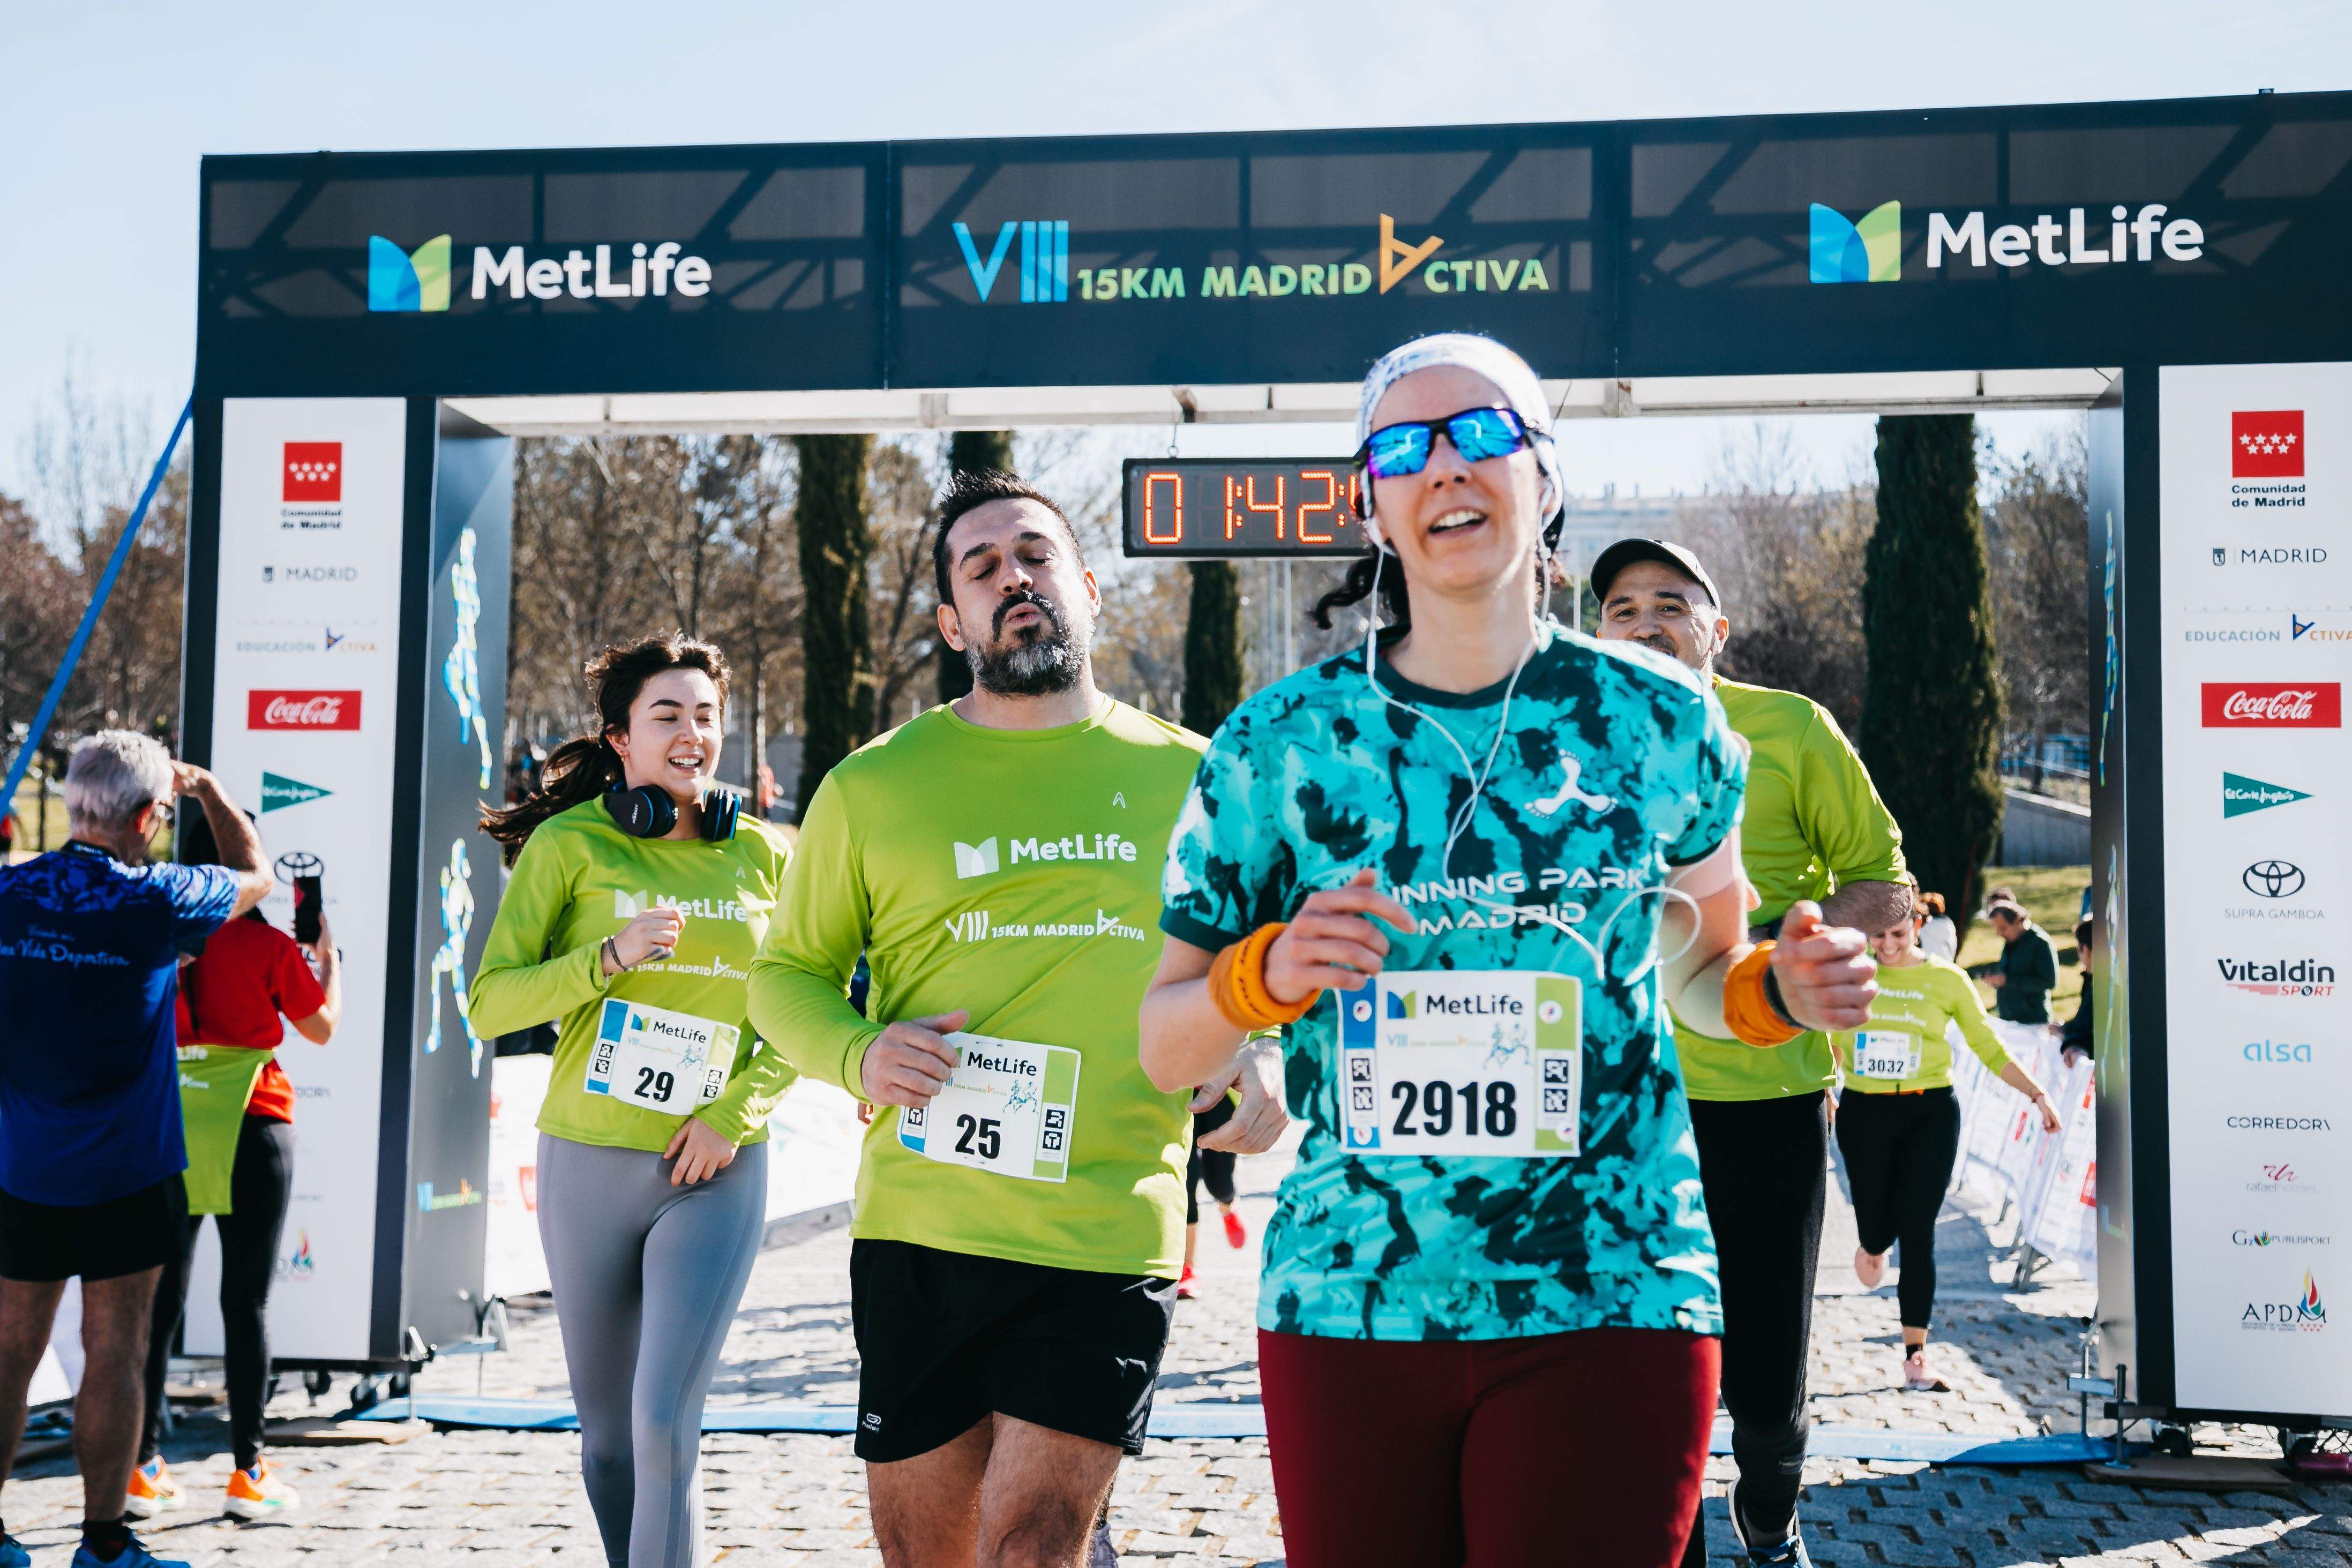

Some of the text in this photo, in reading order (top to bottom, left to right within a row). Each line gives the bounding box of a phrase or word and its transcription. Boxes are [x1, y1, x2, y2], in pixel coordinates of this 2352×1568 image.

[1926, 203, 2205, 268] MetLife
[471, 241, 712, 300] MetLife
[952, 220, 1069, 303] VIII
[1076, 266, 1185, 301] 15KM
[1201, 262, 1373, 298] MADRID
[2231, 484, 2306, 493] Comunidad
[2231, 497, 2305, 507] de Madrid
[2241, 548, 2327, 564] MADRID
[286, 567, 358, 582] MADRID
[2185, 628, 2280, 641] EDUCACIÓN
[1010, 833, 1136, 864] MetLife
[1539, 866, 1644, 891] PARK
[945, 910, 989, 943] VIII
[991, 925, 1028, 939] 15KM
[1033, 924, 1095, 937] MADRID
[1420, 902, 1587, 936] MADRID
[2225, 909, 2325, 920] SUPRA GAMBOA
[637, 963, 664, 973] 15KM
[666, 963, 713, 977] MADRID
[2218, 958, 2335, 982] Vitaldin
[2281, 985, 2335, 997] SPORT
[1426, 994, 1523, 1015] MetLife
[653, 1021, 707, 1044] MetLife
[2244, 1039, 2311, 1063] alsa
[967, 1052, 1037, 1076] MetLife
[1868, 1058, 1904, 1074] 3032
[634, 1067, 674, 1102] 29
[1391, 1081, 1517, 1137] 2918
[955, 1114, 1001, 1159] 25
[2272, 1235, 2331, 1245] PUBLISPORT
